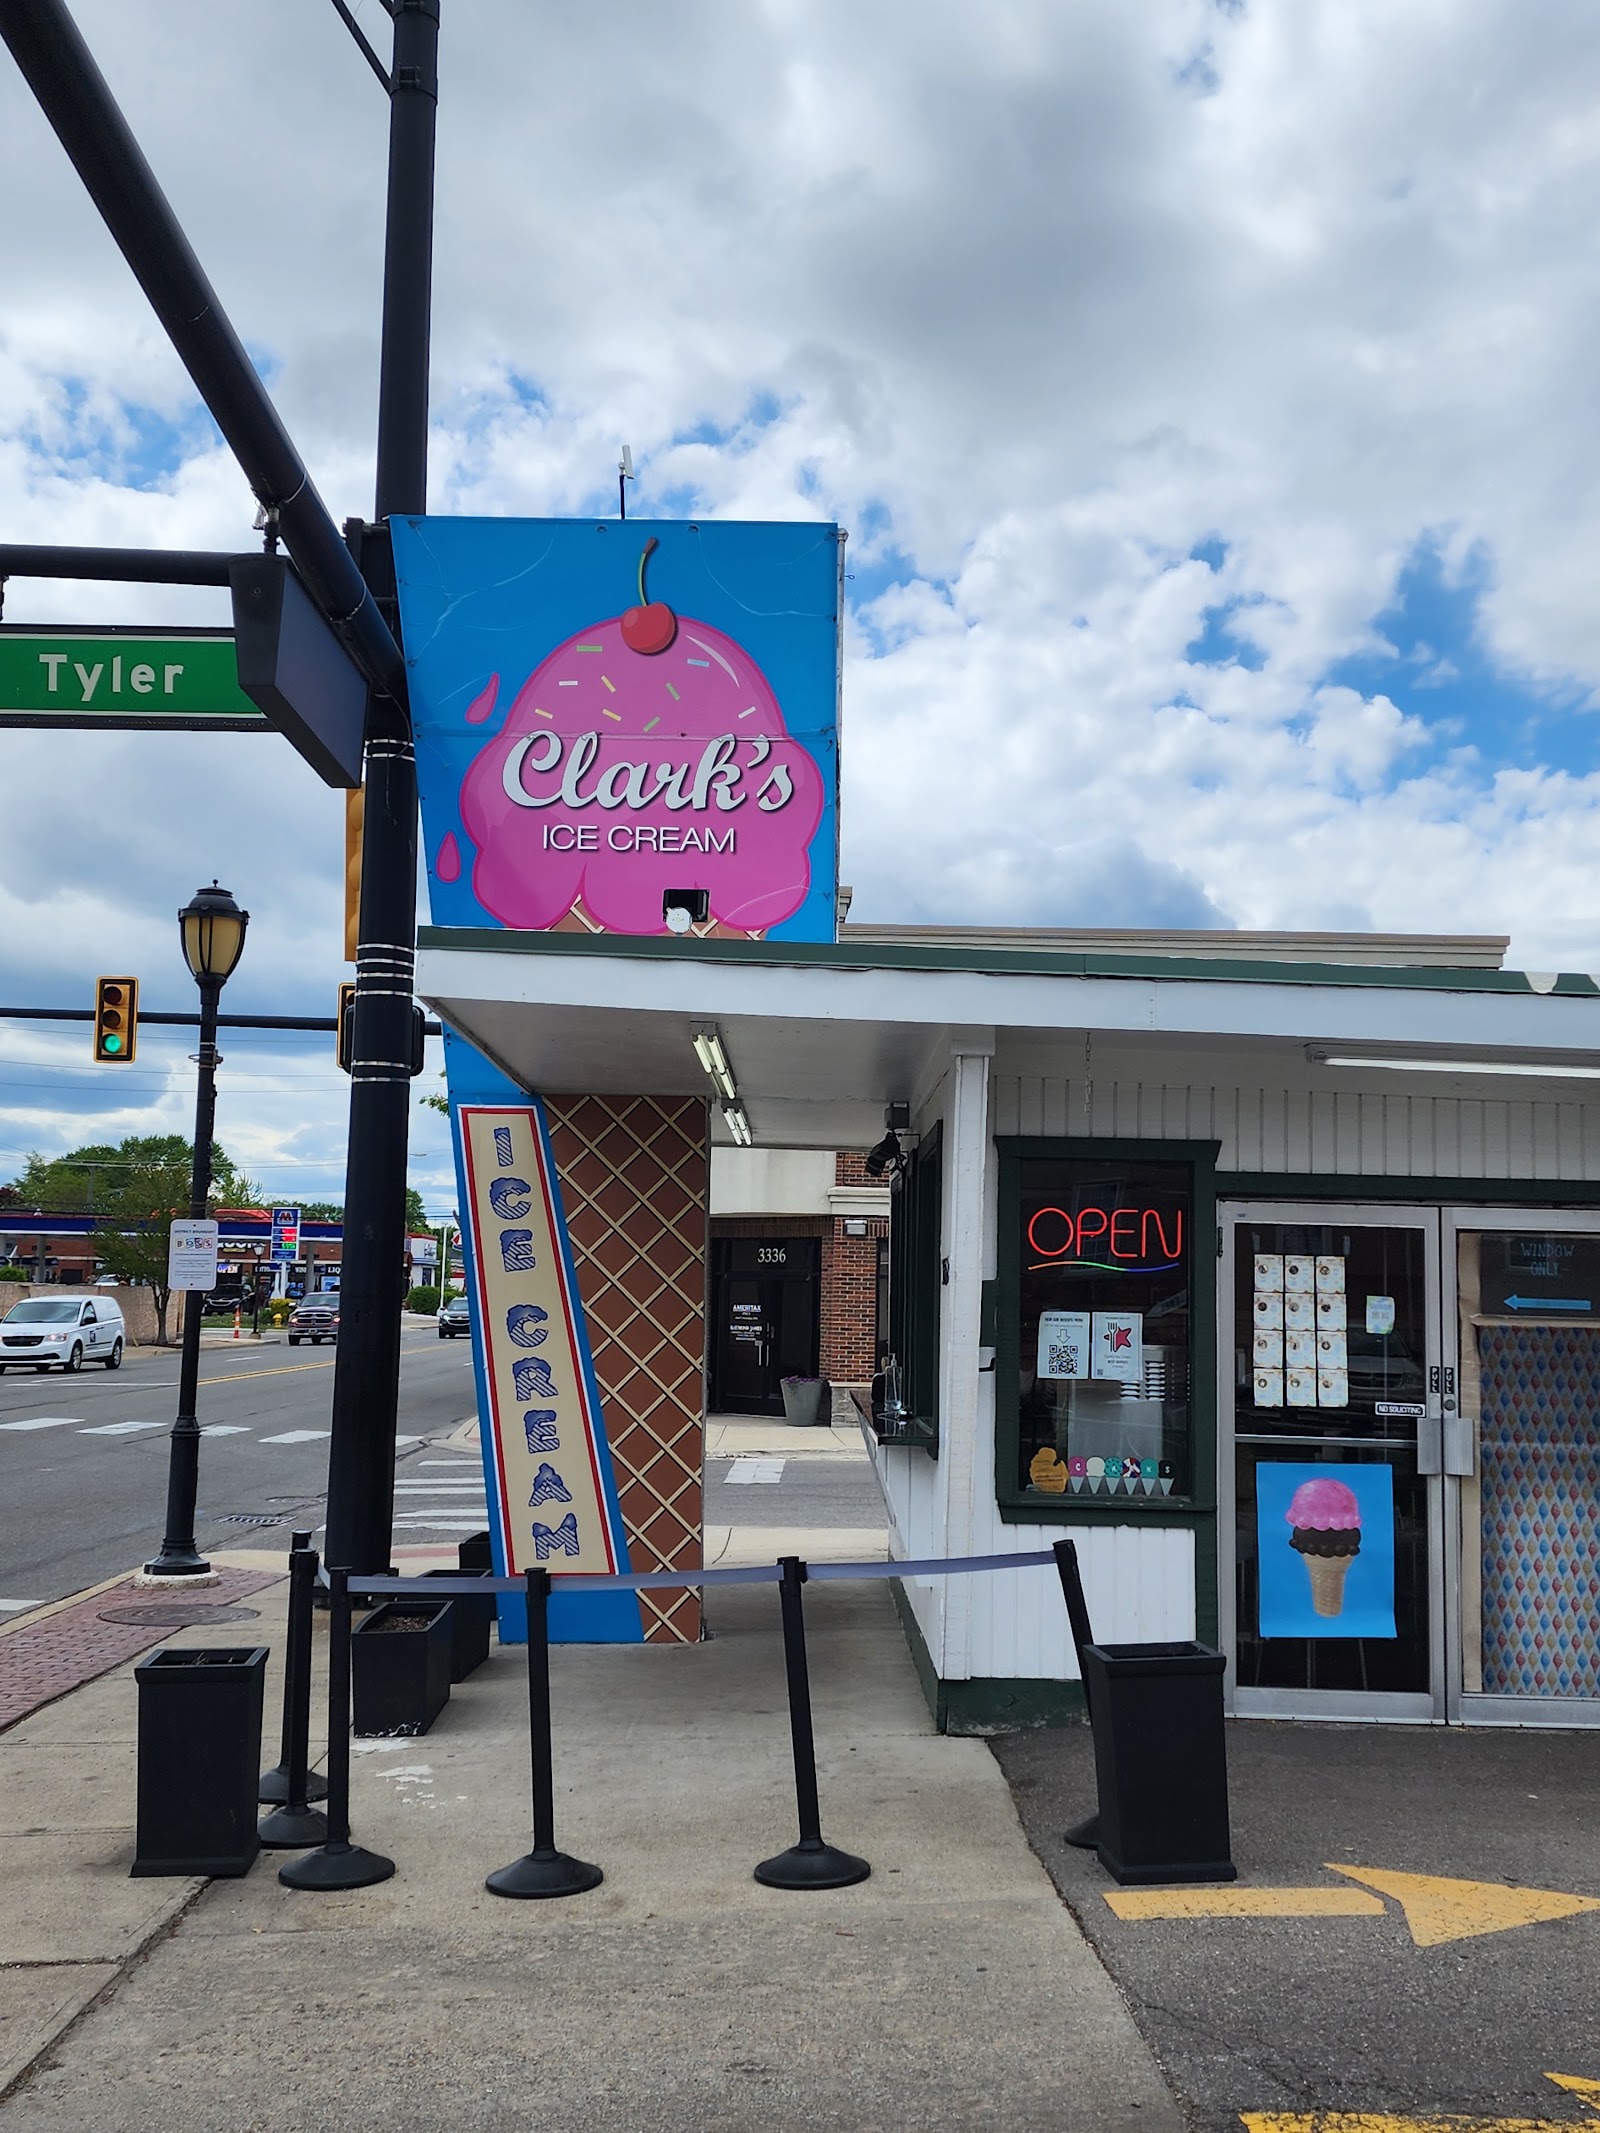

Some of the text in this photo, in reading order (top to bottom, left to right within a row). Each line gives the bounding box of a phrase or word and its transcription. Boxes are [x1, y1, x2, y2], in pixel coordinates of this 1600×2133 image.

[39, 653, 184, 702] Tyler
[502, 729, 793, 811] Clark's
[543, 824, 735, 852] ICE CREAM
[1027, 1207, 1182, 1259] OPEN
[176, 1239, 212, 1248] BOSS
[1520, 1242, 1575, 1257] WINDOW
[757, 1248, 787, 1263] 3336
[217, 1264, 238, 1273] OPEN
[1530, 1261, 1560, 1276] ONLY
[489, 1126, 580, 1561] ICE CREAM
[1389, 1405, 1421, 1414] SOLICITING
